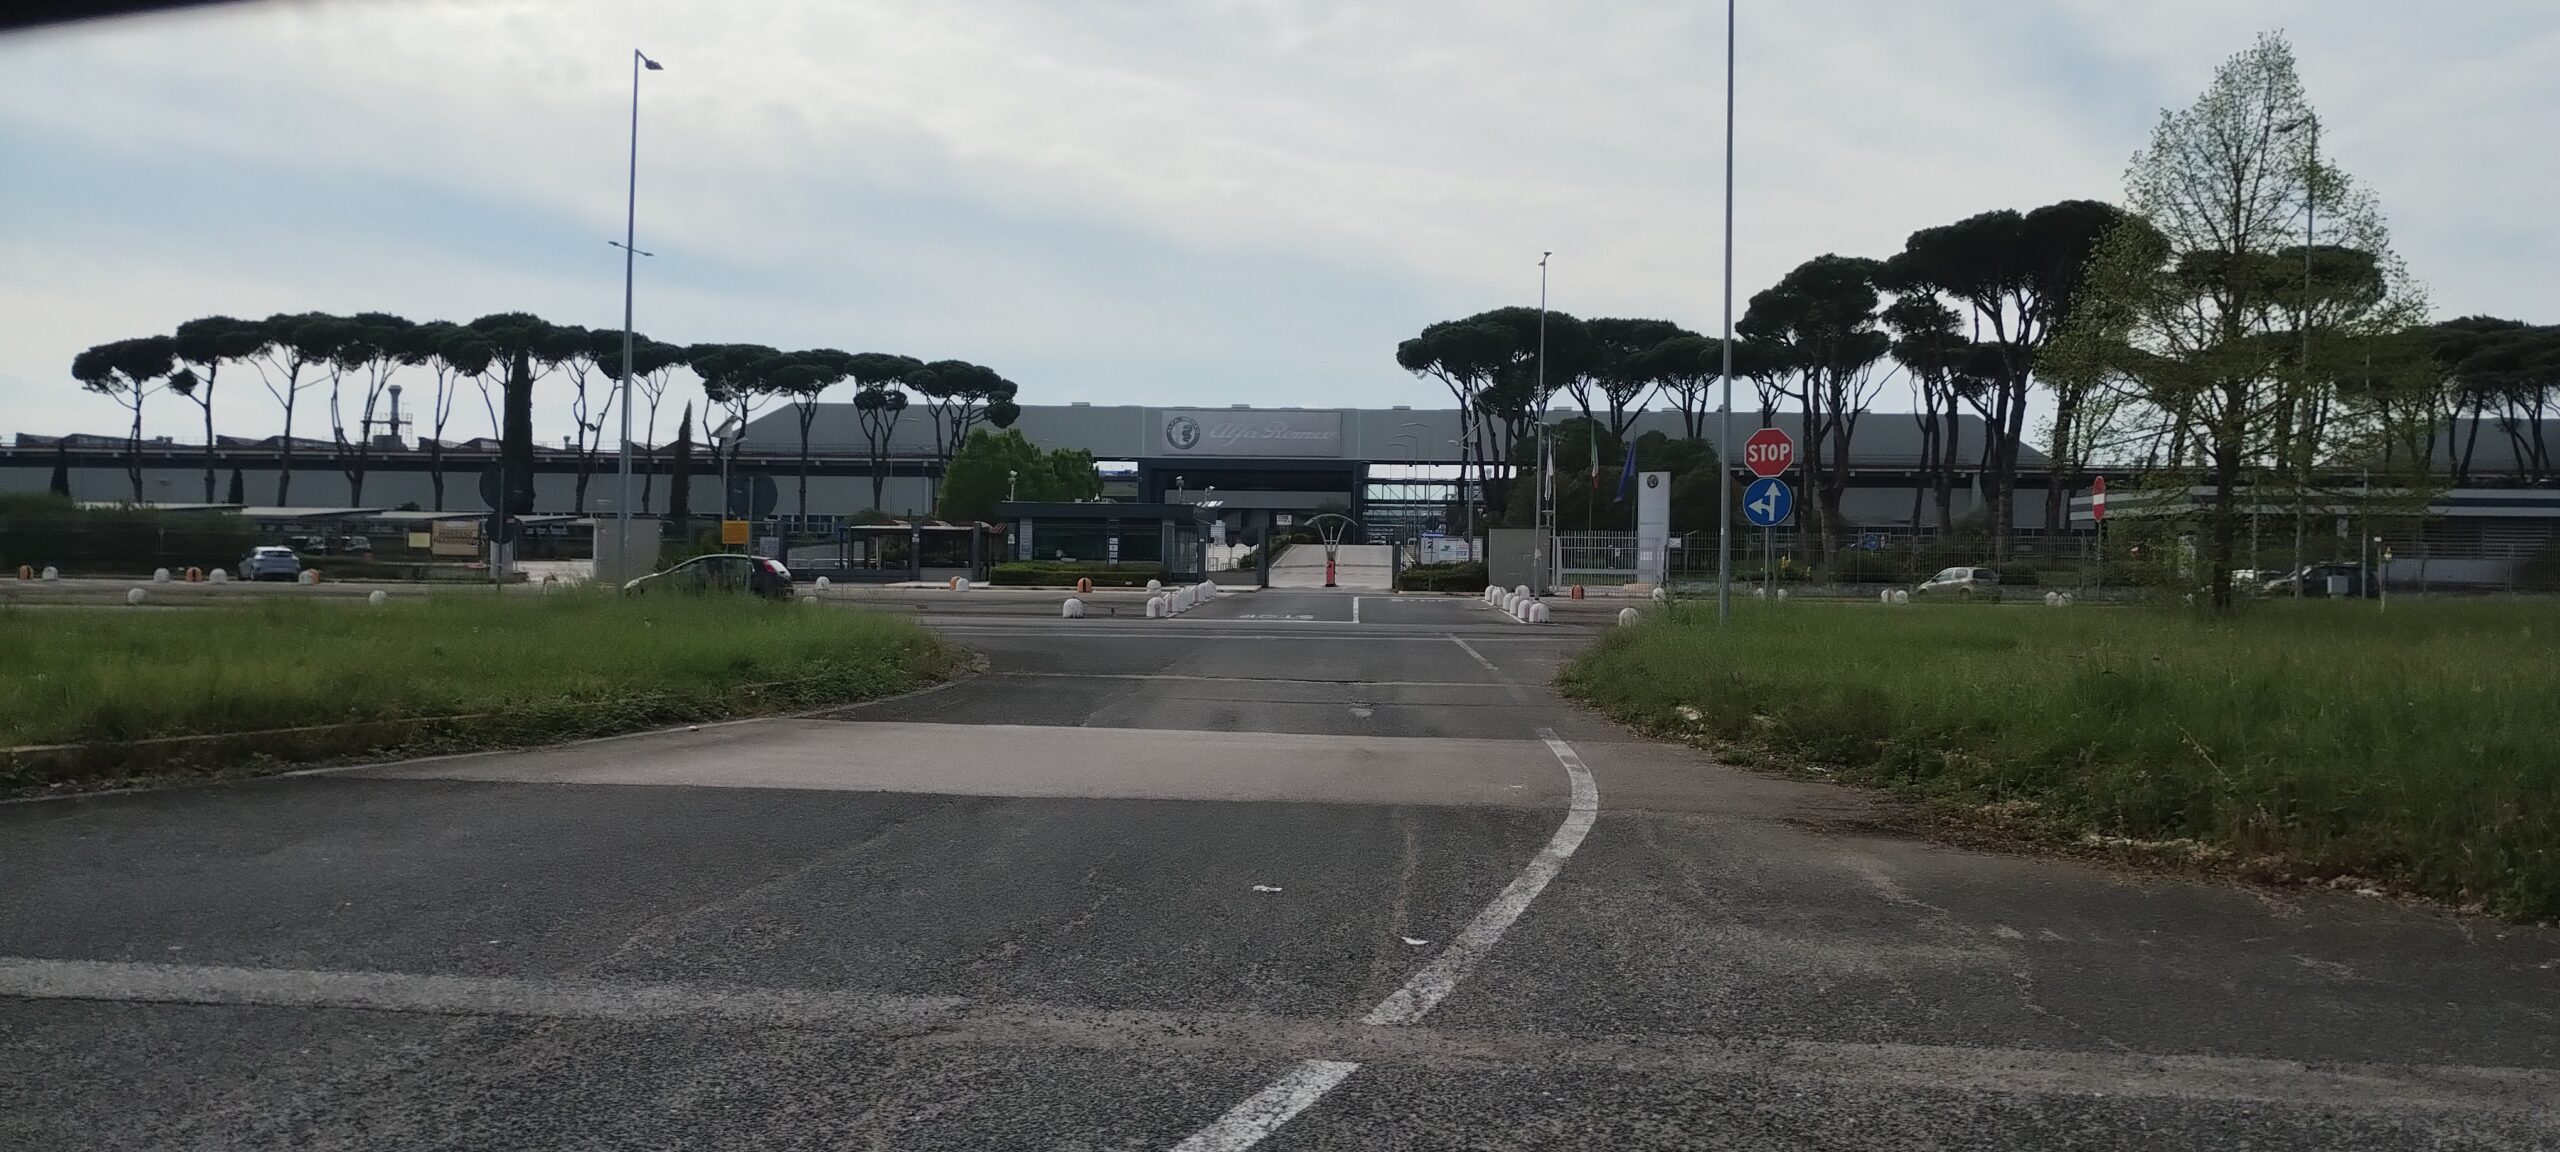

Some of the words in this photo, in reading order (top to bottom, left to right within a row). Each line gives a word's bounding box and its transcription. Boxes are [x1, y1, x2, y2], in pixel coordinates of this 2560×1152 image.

[1209, 423, 1258, 445] Alfa
[1263, 421, 1336, 439] Romeo
[1748, 443, 1790, 462] STOP
